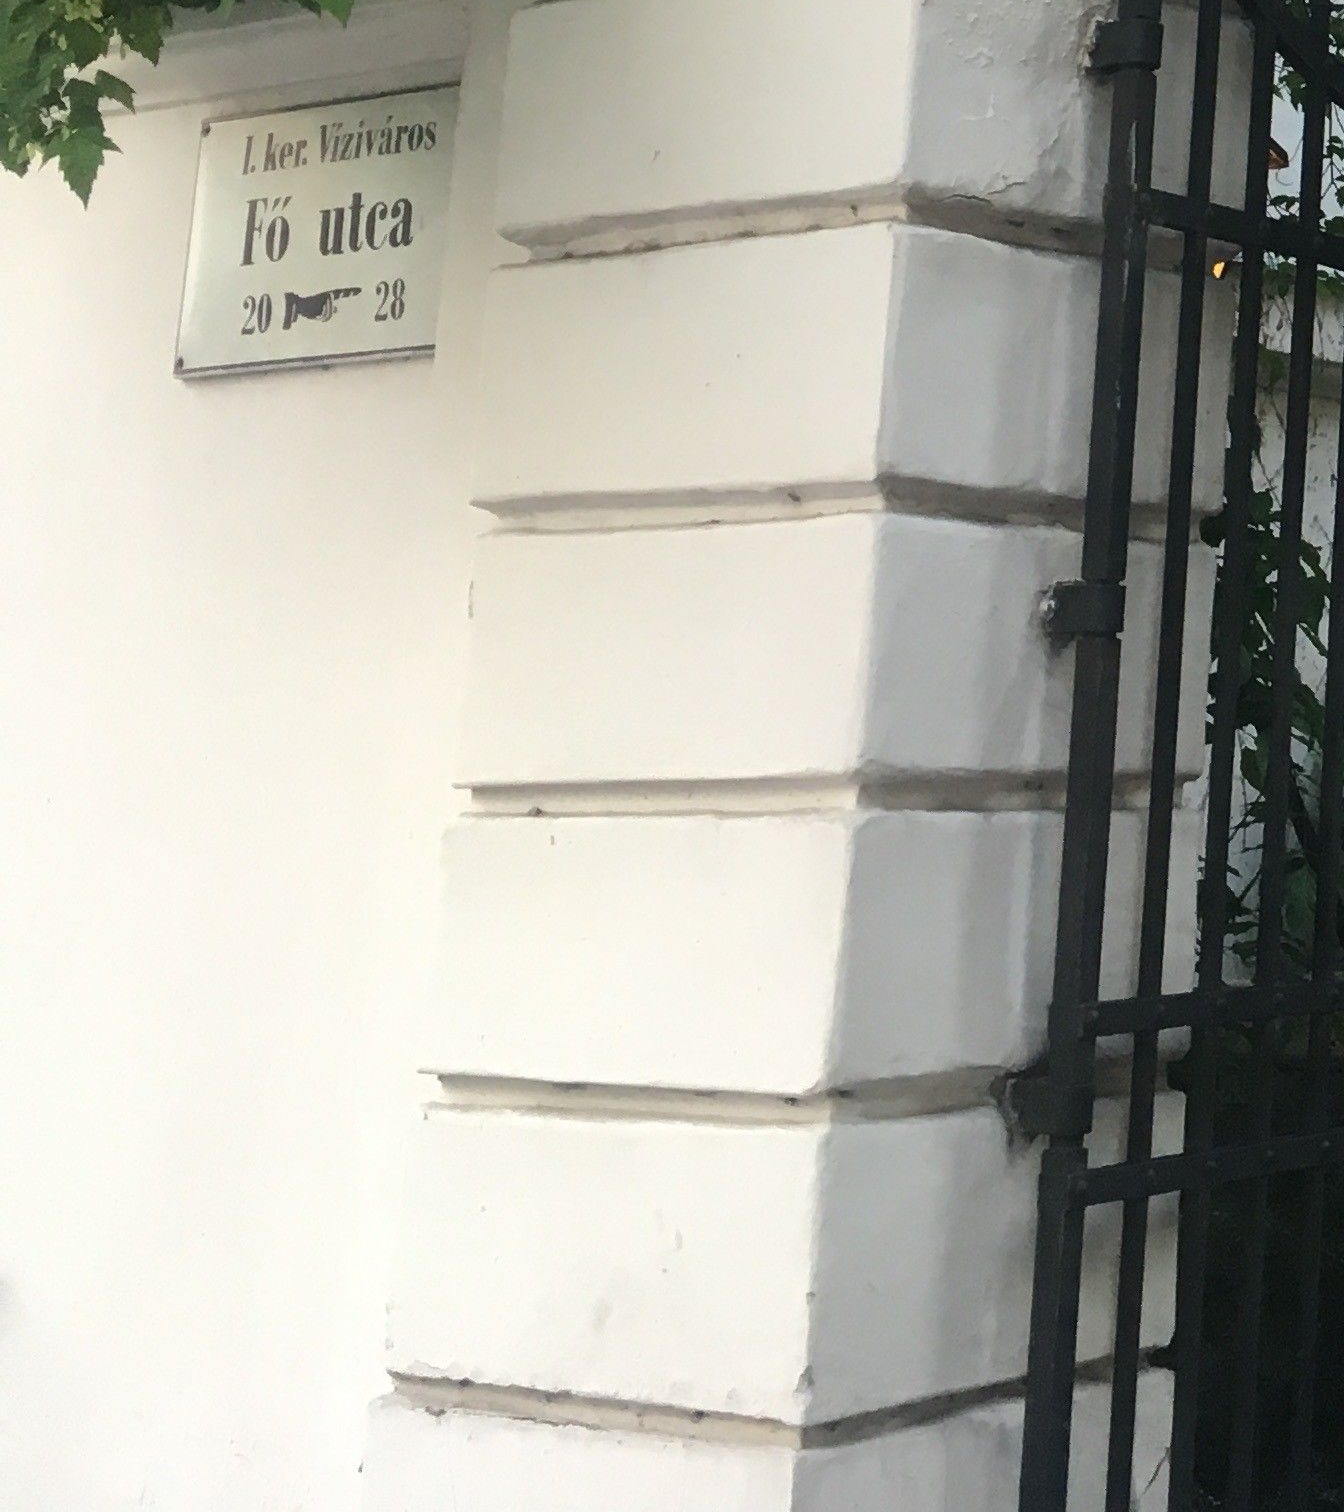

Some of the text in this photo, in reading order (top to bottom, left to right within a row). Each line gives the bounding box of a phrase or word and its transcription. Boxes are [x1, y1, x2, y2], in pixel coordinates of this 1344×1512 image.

[242, 135, 256, 176] I.
[263, 132, 308, 172] ker.
[240, 192, 413, 266] Fő utca
[241, 278, 405, 335] 20 28
